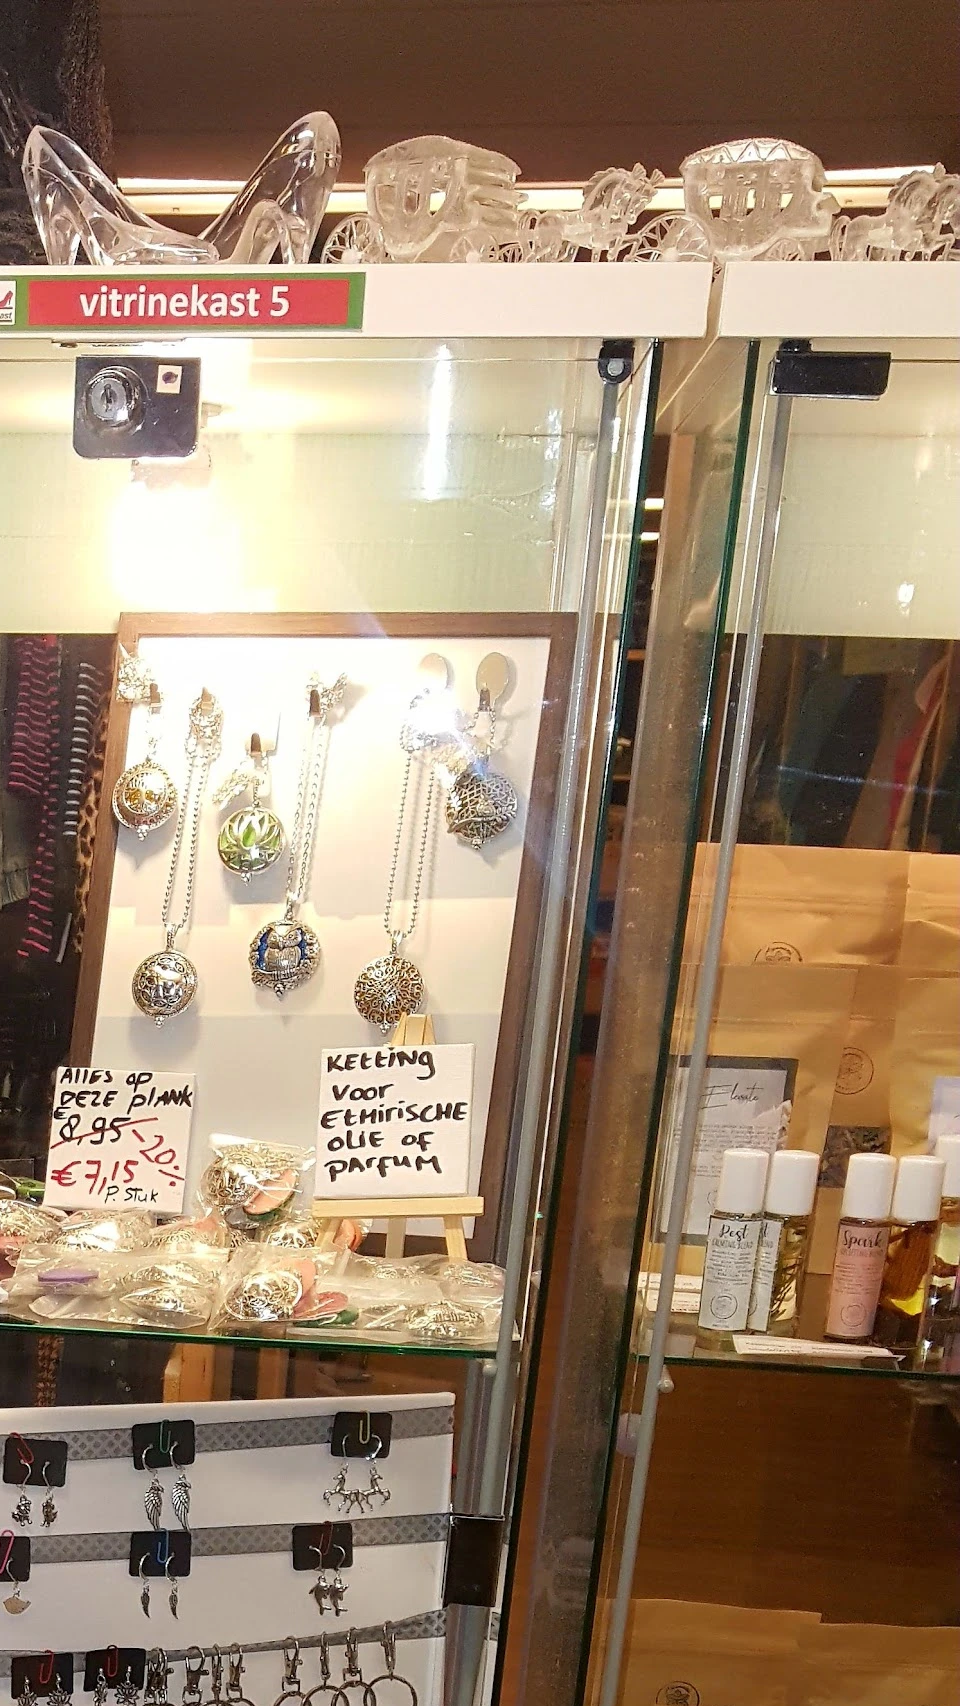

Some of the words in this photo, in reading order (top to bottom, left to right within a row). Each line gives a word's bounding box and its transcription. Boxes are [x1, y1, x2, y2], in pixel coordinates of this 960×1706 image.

[79, 284, 258, 318] vitrinekast
[269, 285, 290, 317] 5
[60, 1090, 119, 1108] DEZE
[843, 1229, 882, 1249] Spark
